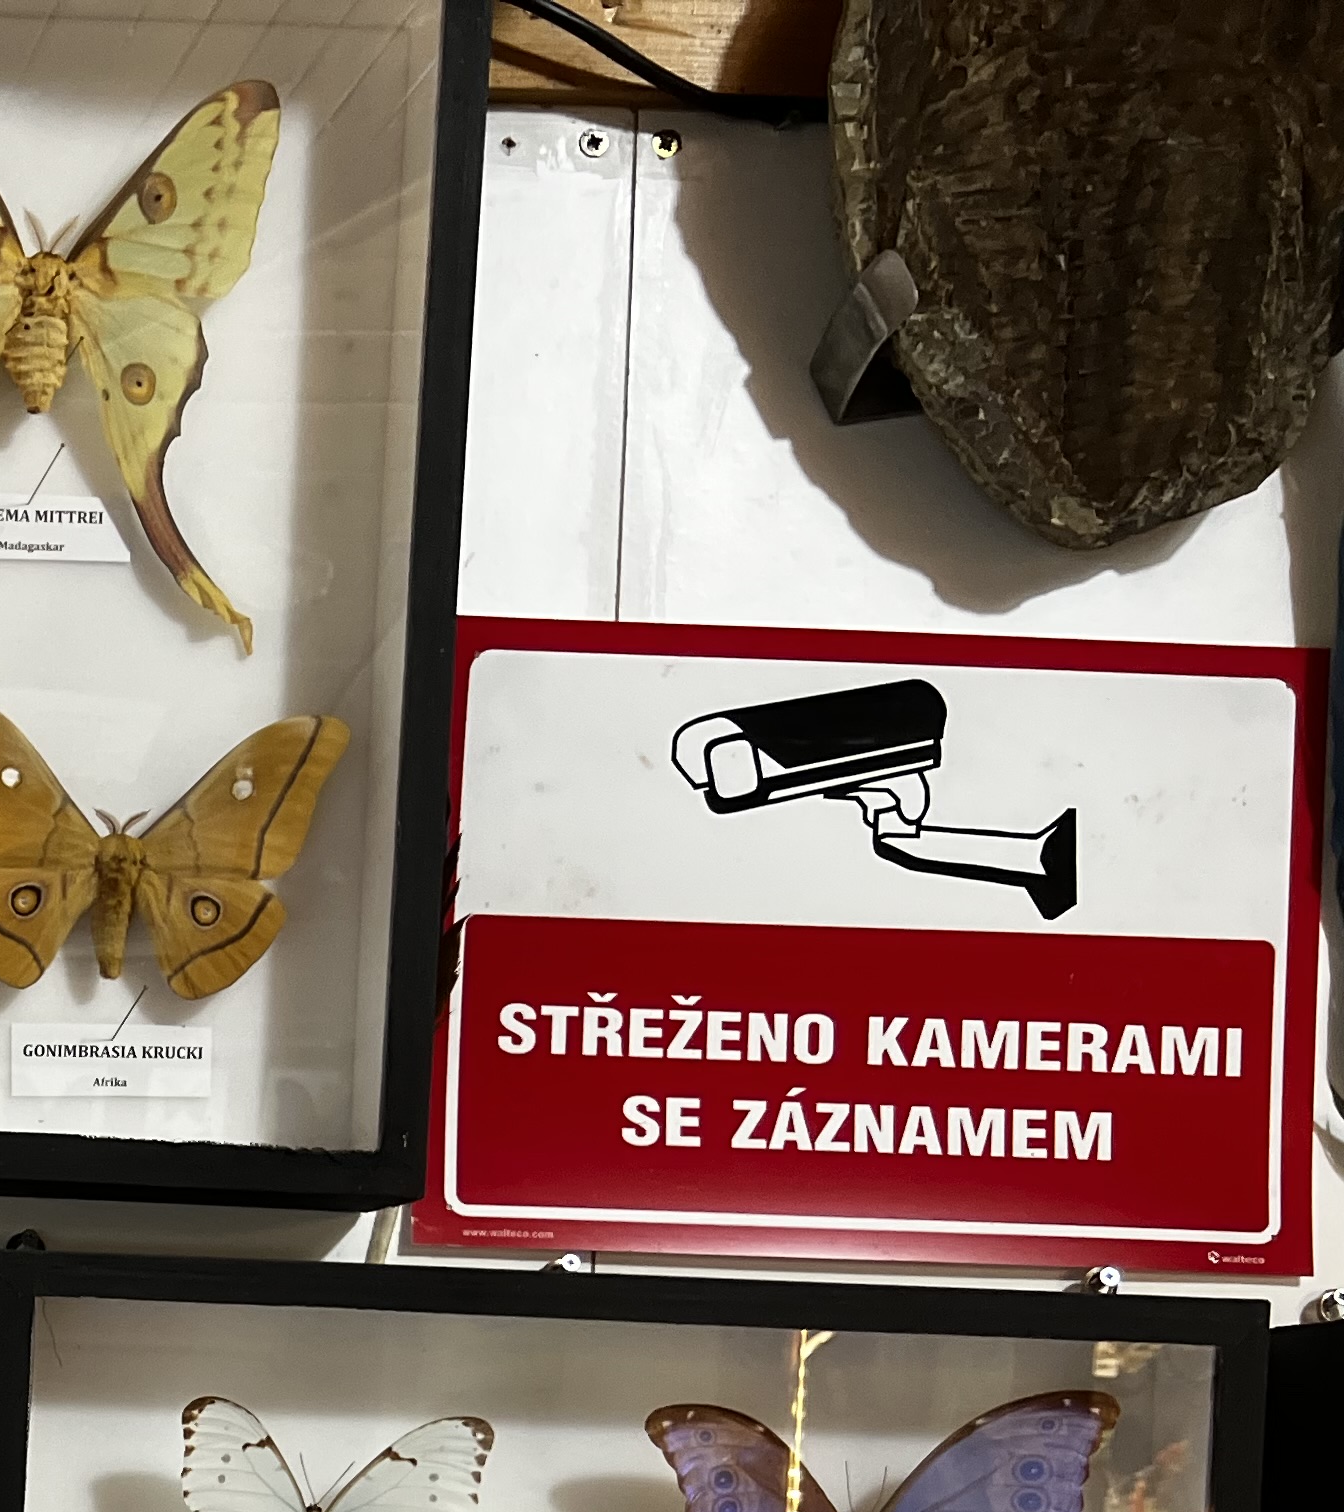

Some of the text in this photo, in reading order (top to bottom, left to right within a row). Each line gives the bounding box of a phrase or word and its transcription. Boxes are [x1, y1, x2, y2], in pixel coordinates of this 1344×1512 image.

[34, 506, 104, 525] MITTREI
[497, 991, 1243, 1078] STŘEŽENO KAMERAMI
[23, 1044, 203, 1060] GONIMBRASIA KRUCKI
[93, 1077, 127, 1088] Afrika
[621, 1087, 1114, 1162] SE ZÁZNAMEM
